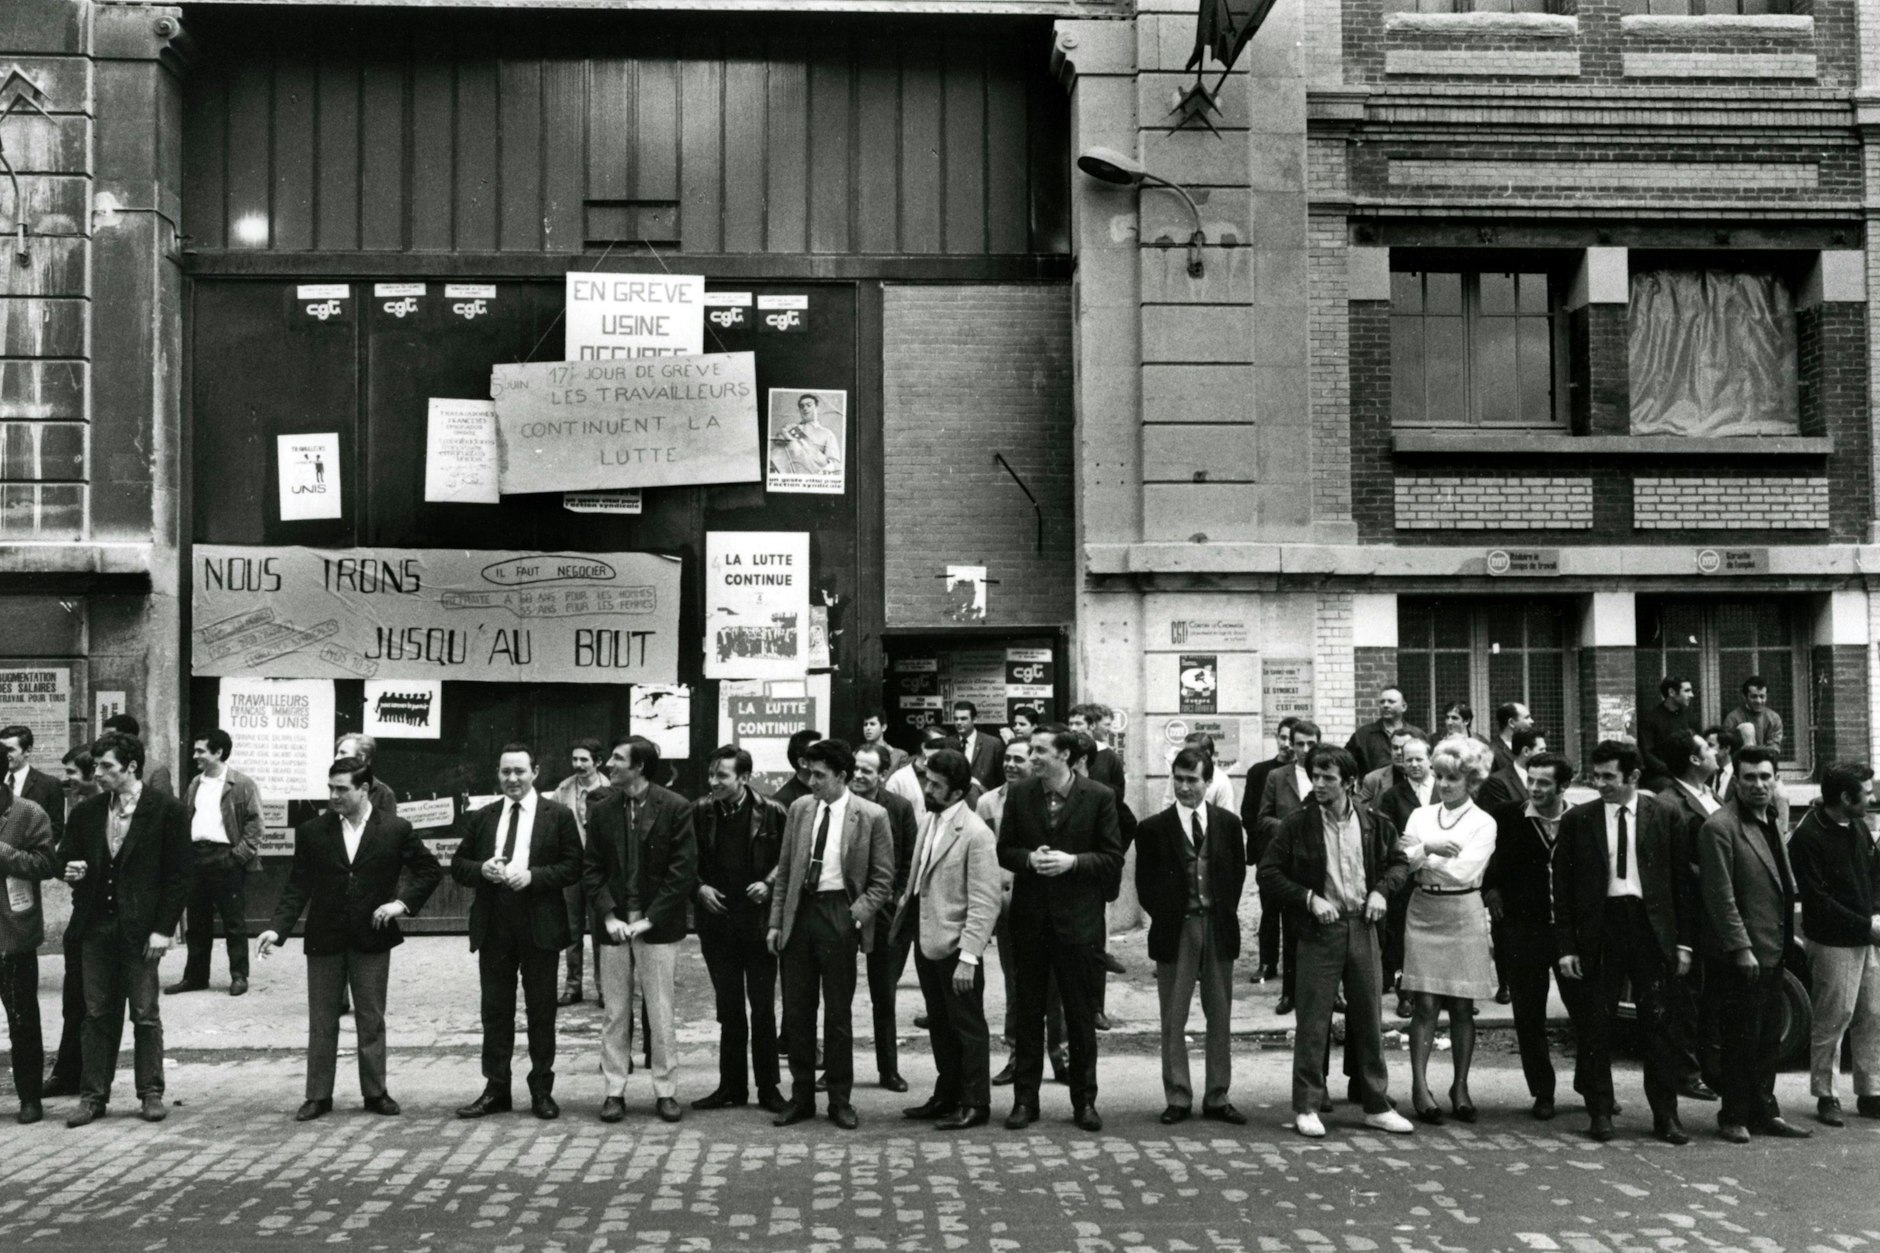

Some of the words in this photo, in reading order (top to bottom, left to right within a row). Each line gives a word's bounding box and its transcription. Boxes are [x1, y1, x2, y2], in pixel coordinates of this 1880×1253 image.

[574, 280, 605, 301] EN
[306, 299, 341, 320] cgt
[383, 297, 418, 318] cgt
[453, 299, 487, 320] cgt
[710, 307, 744, 327] cgt
[766, 310, 800, 331] cgt
[602, 315, 670, 336] USINE
[584, 366, 626, 380] JOUR
[635, 365, 655, 378] DE
[504, 379, 528, 390] JUIN
[551, 389, 587, 405] LES
[596, 382, 750, 401] TRAVAILLEURS
[521, 416, 666, 438] CONTINUENT
[688, 415, 721, 431] LA
[600, 447, 677, 465] LUTTE
[291, 483, 326, 495] UNIS
[725, 554, 742, 566] LA
[752, 554, 793, 566] LUTTE
[205, 557, 281, 592] NOUS
[323, 558, 420, 593] IRONS
[496, 567, 506, 578] IL
[516, 566, 539, 577] FAUT
[725, 574, 792, 586] CONTINUE
[503, 594, 513, 605] A
[537, 592, 555, 602] ANS
[565, 591, 587, 602] POUR
[596, 591, 612, 601] LES
[537, 604, 557, 614] ANS
[565, 602, 589, 613] POUR
[597, 601, 614, 611] LES
[619, 599, 654, 610] FEMMES
[1171, 621, 1186, 644] CGT
[575, 628, 656, 668] BOUT
[0, 671, 57, 682] UGMENTATION
[1013, 663, 1044, 684] cgt
[17, 682, 57, 693] SALAIRES
[28, 694, 46, 702] POUR
[49, 694, 66, 702] TOUS
[231, 694, 309, 708] TRAVAILLEURS
[737, 701, 756, 714] LA
[765, 702, 807, 715] LUTTE
[231, 716, 269, 729] TOUS
[276, 717, 309, 730] UNIS
[906, 711, 935, 730] cgt
[737, 722, 806, 735] CONTINUE
